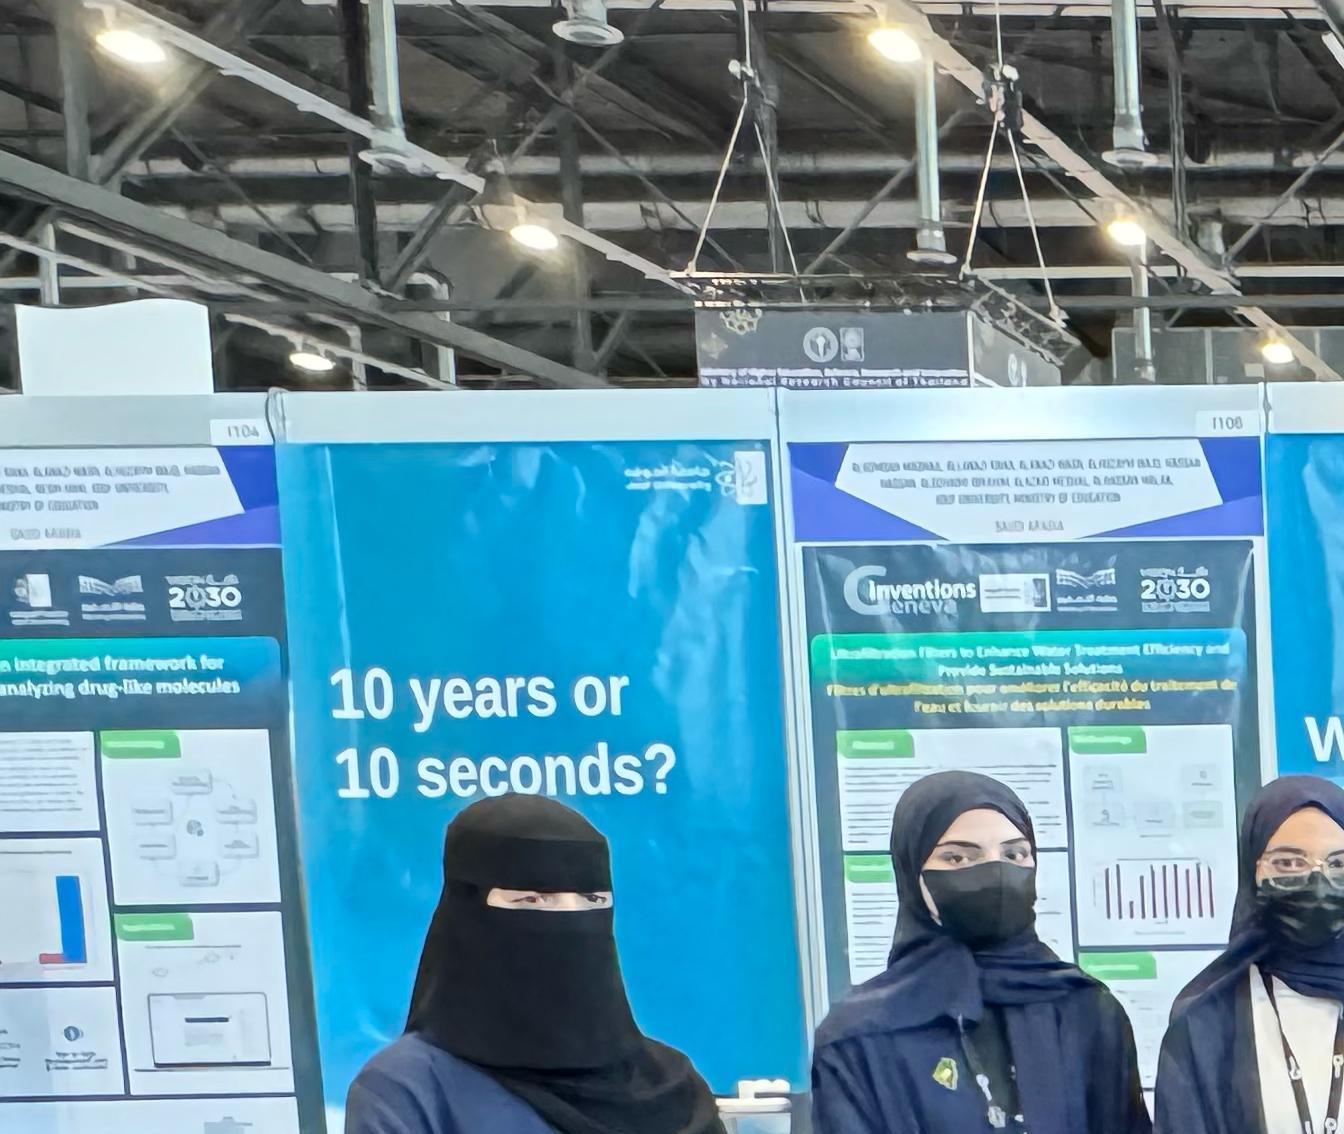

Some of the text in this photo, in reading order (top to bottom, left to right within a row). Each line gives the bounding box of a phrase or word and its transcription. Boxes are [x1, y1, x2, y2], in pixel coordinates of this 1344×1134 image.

[168, 586, 242, 608] 2030
[1140, 579, 1210, 600] 2030
[14, 654, 224, 676] integrated framework for
[78, 678, 152, 699] drug-like
[156, 677, 240, 695] molecules
[330, 667, 630, 733] 10 years or
[335, 741, 677, 798] 10 seconds?
